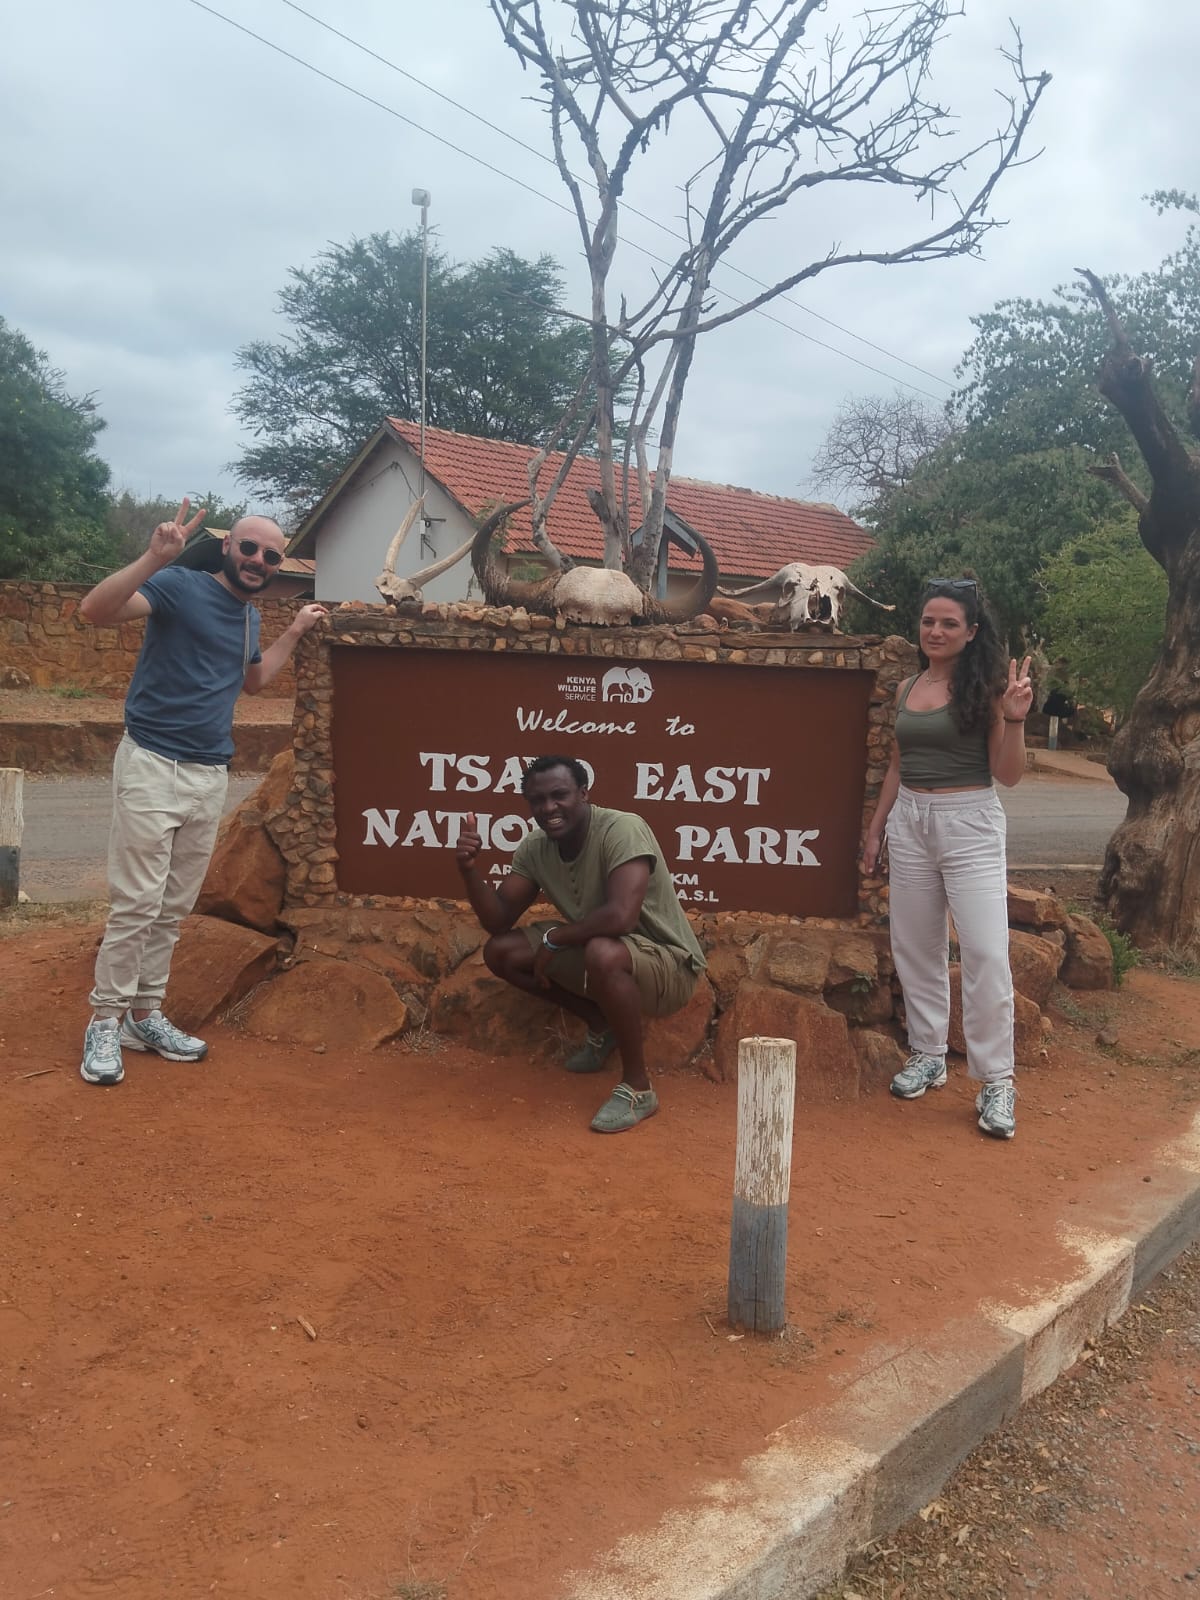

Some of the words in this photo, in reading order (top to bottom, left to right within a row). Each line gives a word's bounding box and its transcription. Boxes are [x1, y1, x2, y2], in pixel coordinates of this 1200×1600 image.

[557, 684, 597, 693] WILDLIFE
[566, 676, 597, 685] KENYA
[564, 693, 597, 702] SERVICE
[516, 706, 637, 735] Welcome
[665, 715, 696, 736] to
[419, 751, 595, 794] TSA
[633, 762, 771, 806] EAST
[361, 808, 541, 852] NATIO
[674, 825, 822, 866] PARK
[488, 863, 513, 875] AR
[670, 873, 699, 886] KM
